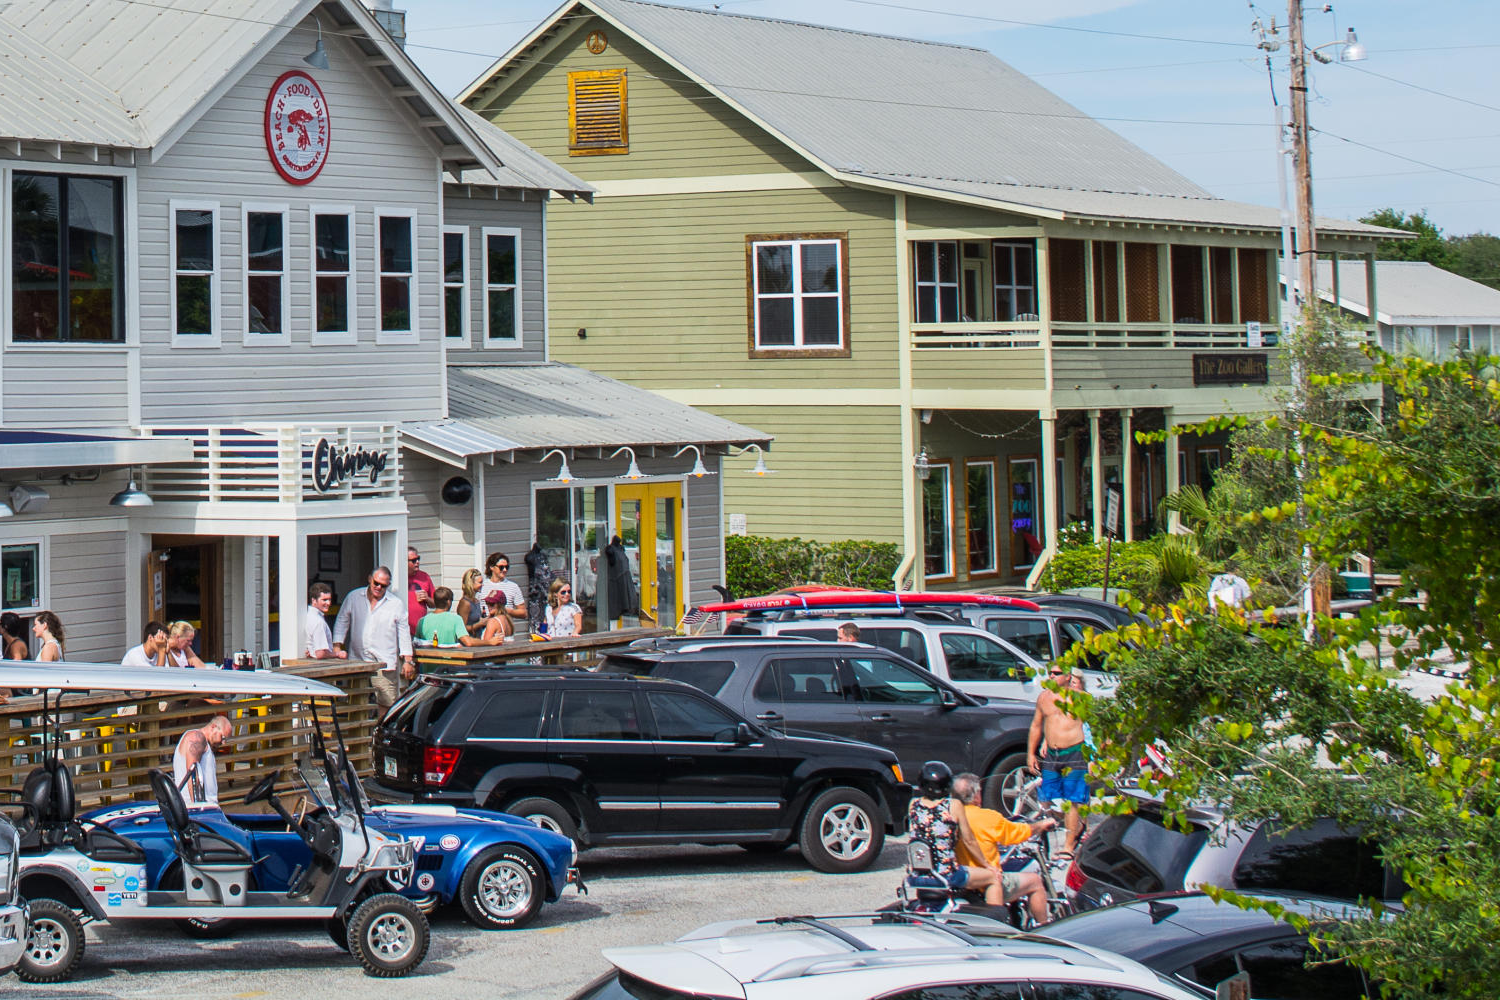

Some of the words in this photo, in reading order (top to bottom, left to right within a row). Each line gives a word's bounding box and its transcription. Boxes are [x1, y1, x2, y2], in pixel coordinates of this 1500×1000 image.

[275, 99, 285, 151] BEACH
[287, 83, 311, 96] FOOD
[313, 98, 325, 147] DRINK
[1199, 359, 1216, 375] The
[1217, 359, 1234, 375] Zoo
[313, 437, 387, 493] Chiringo
